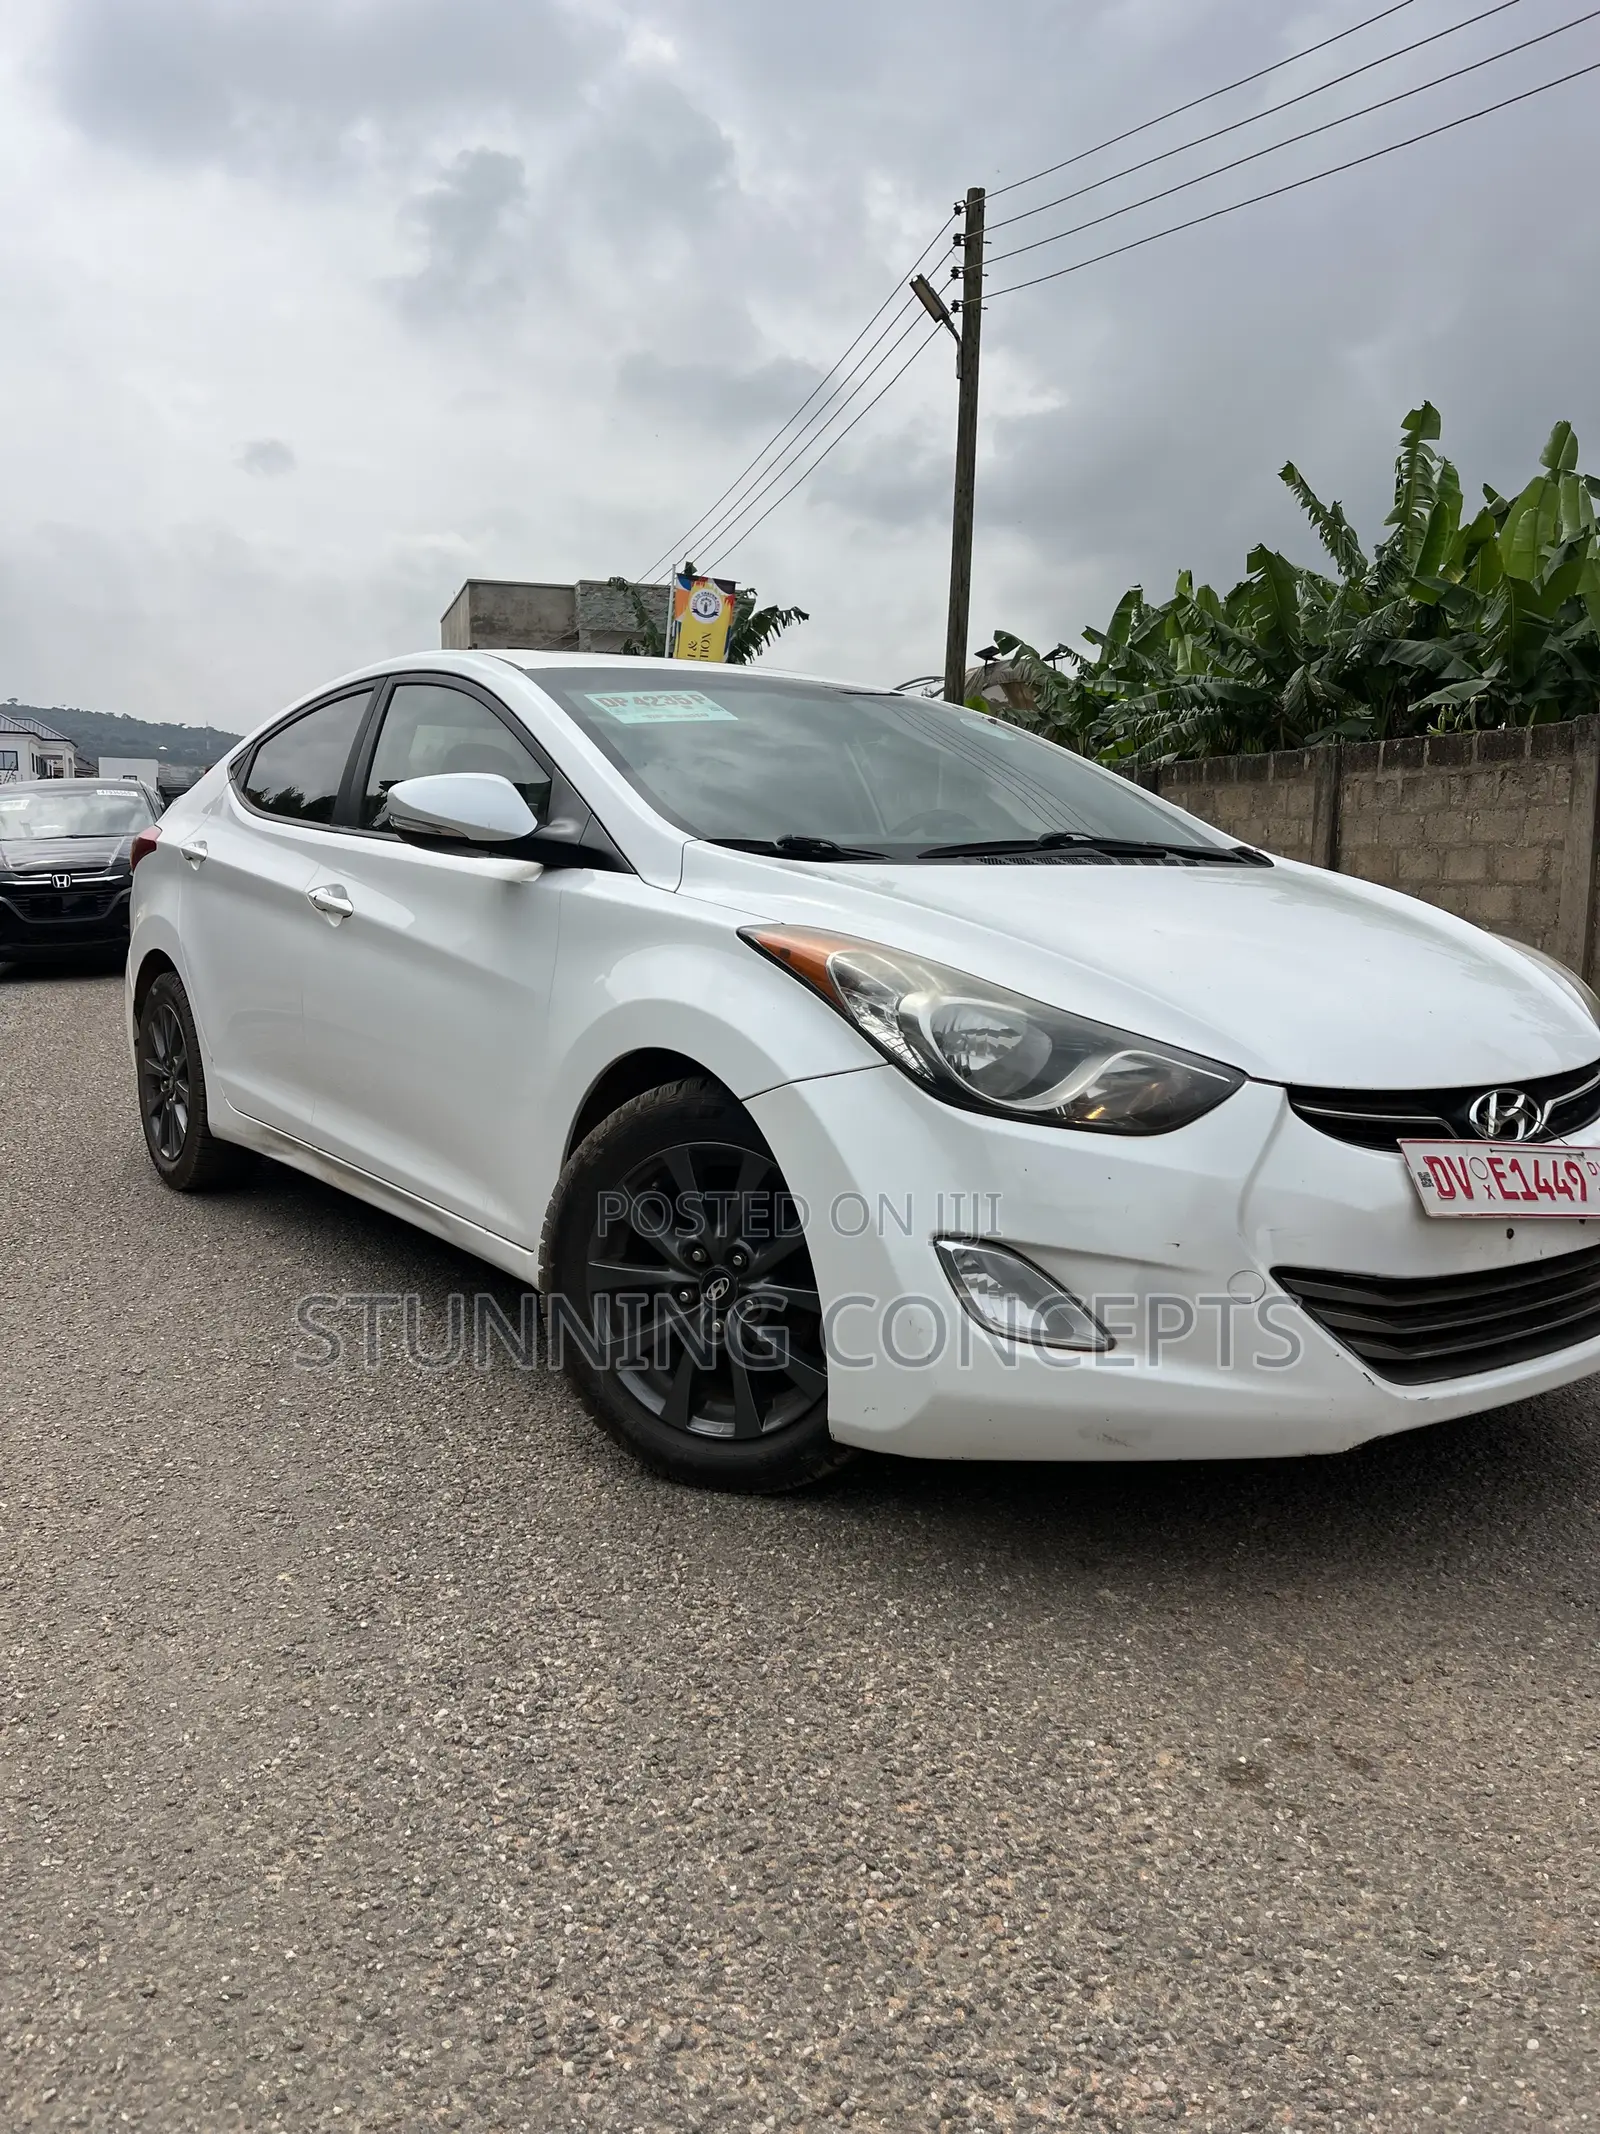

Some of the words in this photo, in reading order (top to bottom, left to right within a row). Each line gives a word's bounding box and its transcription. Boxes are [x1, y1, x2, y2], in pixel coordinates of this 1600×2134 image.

[595, 697, 629, 708] DP
[632, 694, 694, 707] 4235
[1422, 1155, 1475, 1200] DV
[1486, 1156, 1588, 1202] E1449
